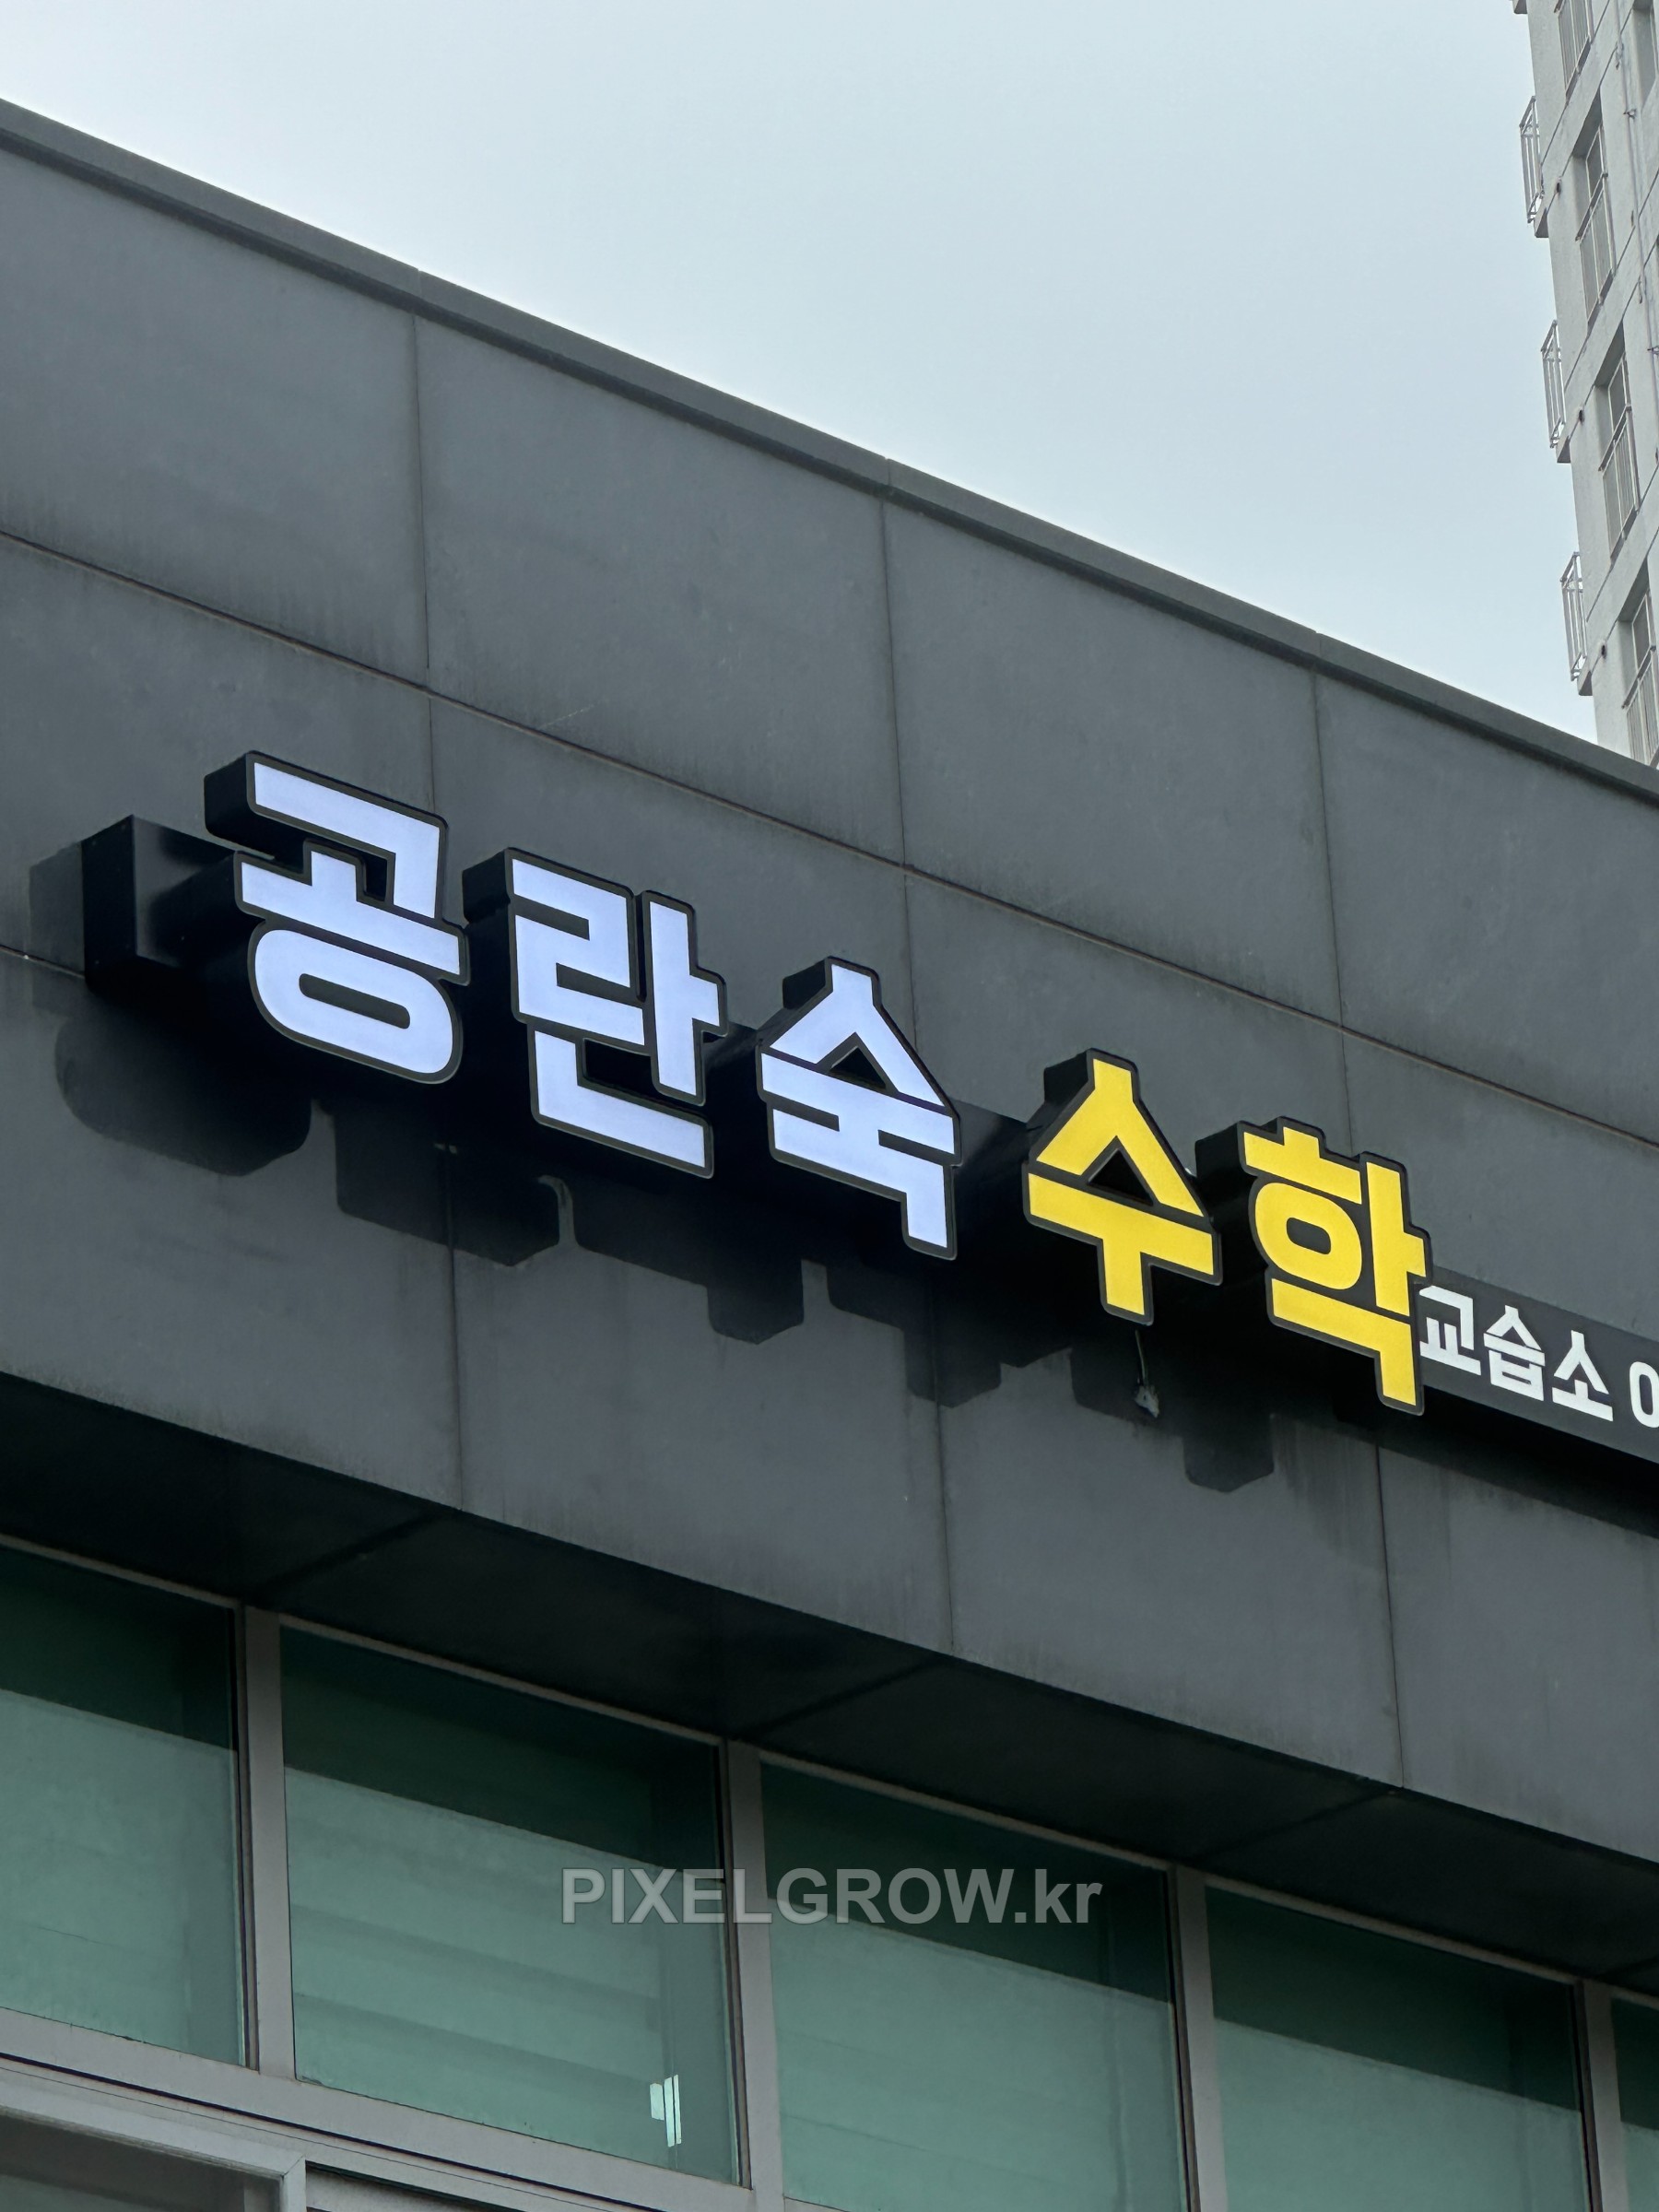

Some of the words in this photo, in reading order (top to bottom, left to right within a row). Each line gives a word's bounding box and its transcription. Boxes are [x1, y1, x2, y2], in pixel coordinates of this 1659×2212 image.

[241, 760, 957, 1250] 공란숙
[1027, 1057, 1427, 1407] 수학
[1418, 1285, 1614, 1422] 교습소
